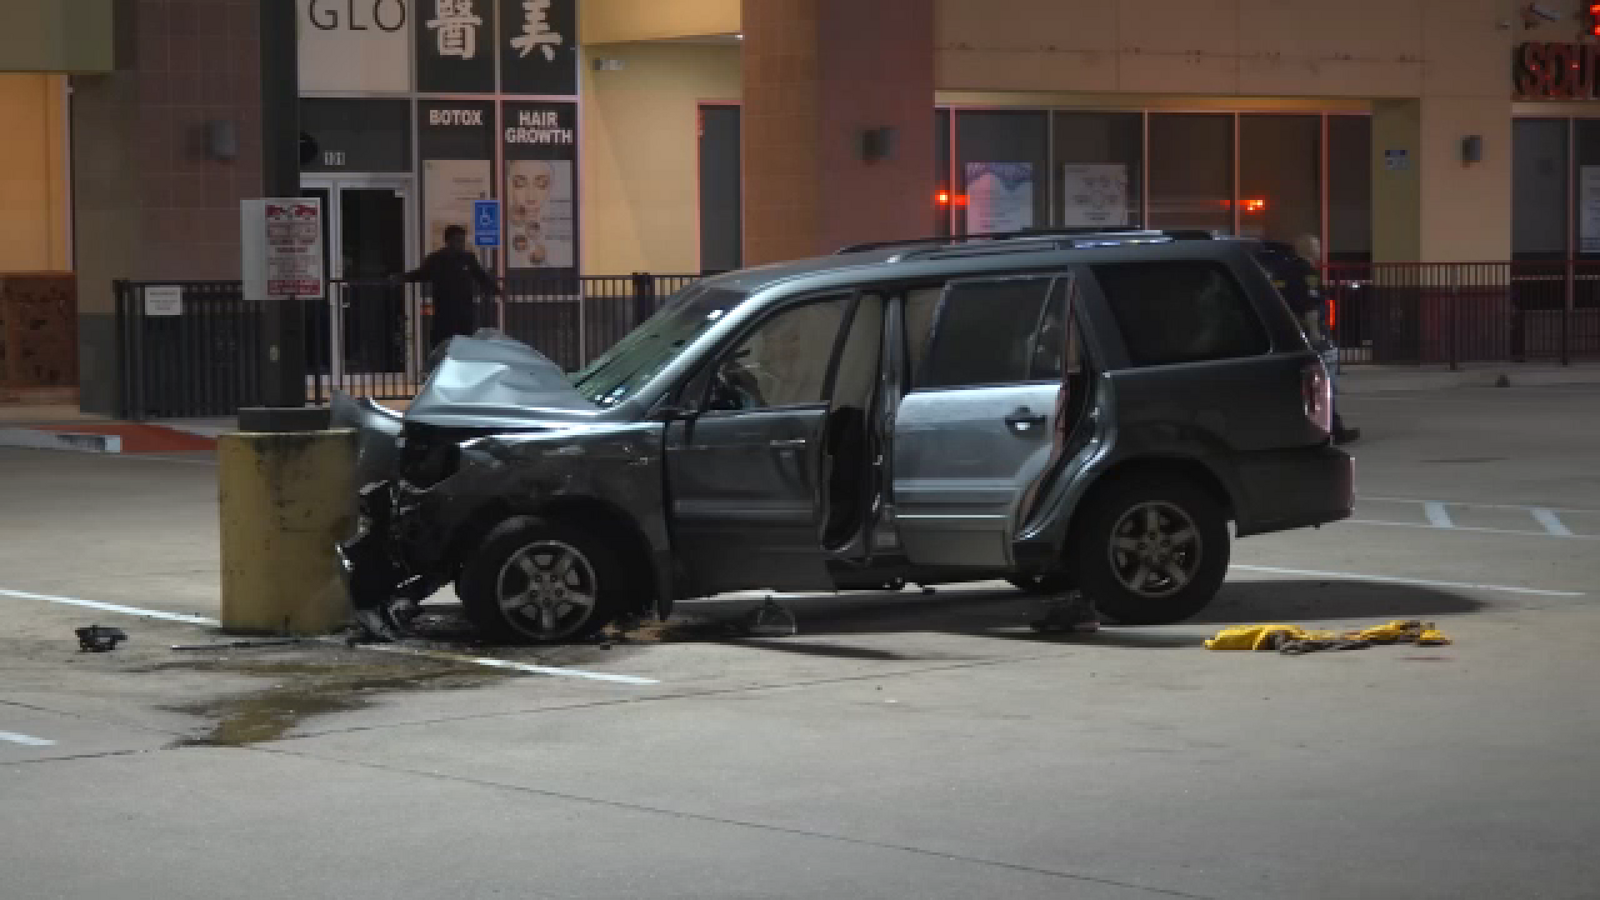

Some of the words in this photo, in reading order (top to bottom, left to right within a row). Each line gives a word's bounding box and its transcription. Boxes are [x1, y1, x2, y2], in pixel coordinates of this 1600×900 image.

[309, 0, 406, 32] GLO
[429, 109, 483, 126] BOTOX
[519, 111, 558, 127] HAIR
[505, 127, 573, 144] GROWTH
